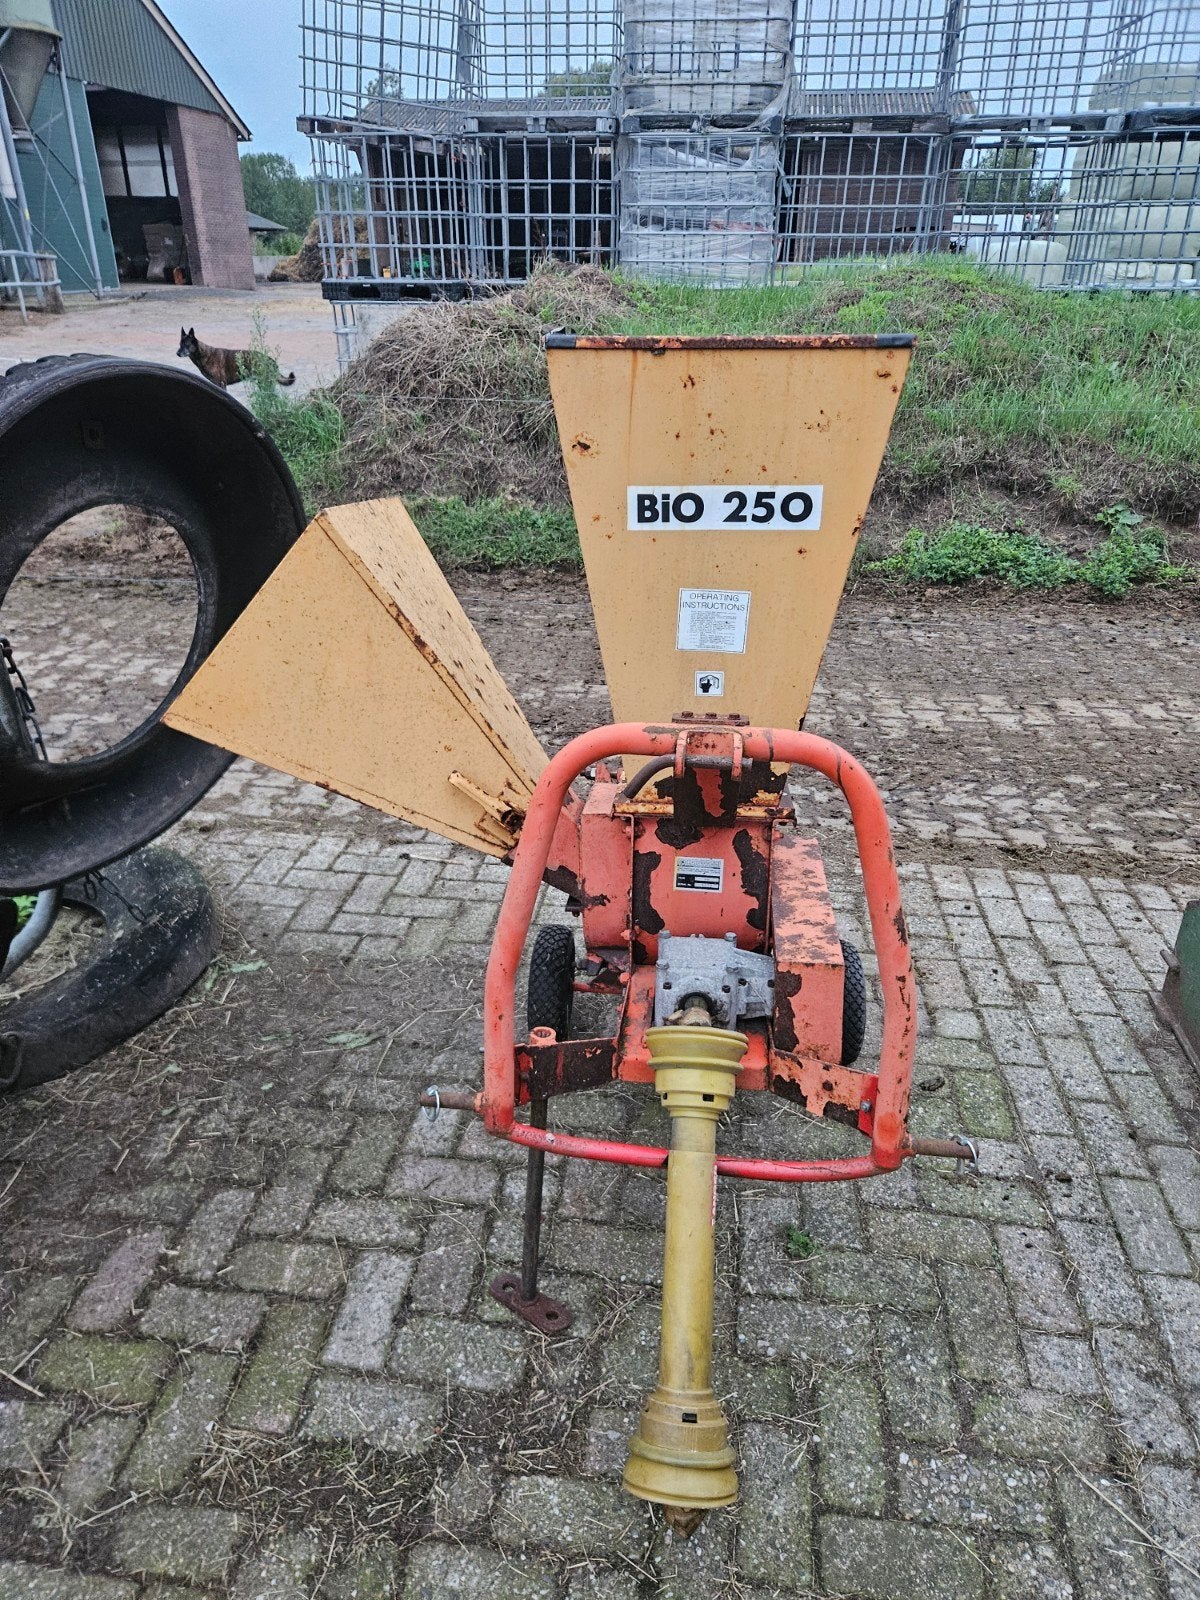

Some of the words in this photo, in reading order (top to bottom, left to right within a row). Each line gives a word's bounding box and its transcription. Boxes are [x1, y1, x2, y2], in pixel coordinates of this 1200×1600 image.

[637, 492, 704, 523] BiO
[722, 490, 813, 523] 250
[689, 592, 740, 602] OPERATING
[682, 601, 746, 612] INSTRUCTIONS
